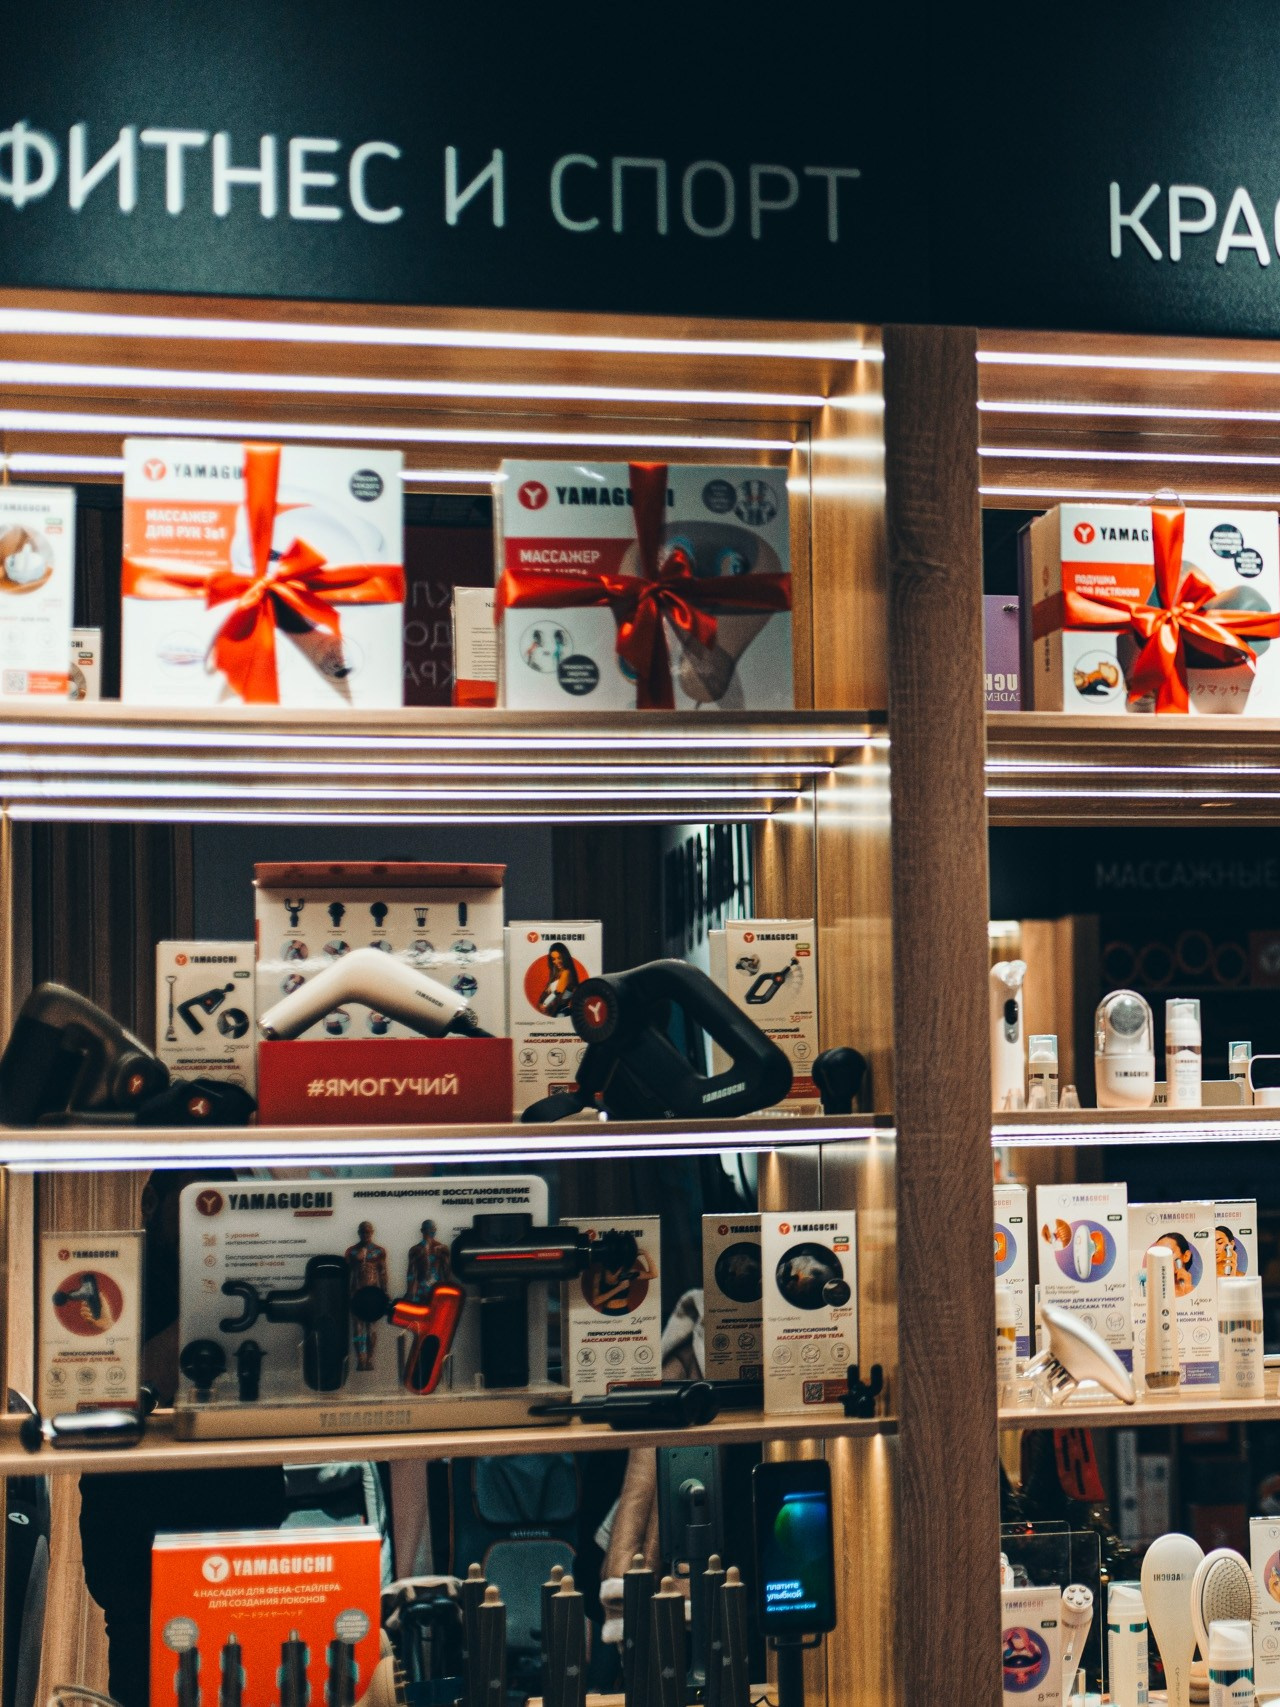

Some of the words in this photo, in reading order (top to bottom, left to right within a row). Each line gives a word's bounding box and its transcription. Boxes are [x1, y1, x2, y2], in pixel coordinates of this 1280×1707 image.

[0, 119, 403, 225] ФИТНЕС
[443, 145, 506, 229] И
[549, 152, 862, 244] СПОРТ
[145, 508, 219, 524] МАССАЖЕР
[519, 549, 601, 564] МАССАЖЕР
[1074, 574, 1117, 586] ПОДУШКА
[1095, 859, 1280, 890] МАССАЖНЫЕ
[541, 933, 585, 941] YAMAGUCHI
[756, 933, 798, 941] YAMAGUCHI
[189, 955, 237, 964] YAMAGUCHI
[414, 989, 445, 1008] YAMAGUCHI
[177, 1057, 234, 1065] ПЕРКУССИОННЫЙ
[307, 1073, 459, 1098] #ЯМОГУЧИЙ
[702, 1082, 746, 1104] YAMAGUCHI
[353, 1189, 441, 1199] ИННОВАЦИОННОЕ
[442, 1186, 530, 1197] ВОССТАНОВЛЕНИЕ
[228, 1191, 333, 1211] YAMAGUCHI
[441, 1197, 474, 1206] МЫШЦ
[475, 1196, 504, 1204] ВСЕГО
[506, 1196, 530, 1204] ТЕЛА
[1159, 1212, 1196, 1220] YAMAGUCHI
[792, 1223, 838, 1232] YAMAGUCHI
[231, 1232, 260, 1240] уровней
[72, 1250, 119, 1259] YAMAGUCHI
[587, 1329, 642, 1337] ПЕРКУССИОННЫЙ
[783, 1325, 838, 1333] ПЕРКУССИОННЫЙ
[318, 1410, 413, 1429] YAMAGUCHI
[232, 1556, 333, 1577] YAMAGUCHI
[200, 1589, 244, 1598] НАСАДКИ
[245, 1588, 265, 1596] ДЛЯ
[266, 1583, 341, 1595] ФЕНА-СТАЙЛЕРА
[766, 1581, 799, 1591] платите
[208, 1601, 227, 1609] ДЛЯ
[228, 1598, 279, 1607] СОЗДАНИЯ
[280, 1595, 326, 1605] ЛОКОНОВ
[766, 1590, 803, 1602] улыбкой
[1005, 1600, 1044, 1610] YAMAGUCHI
